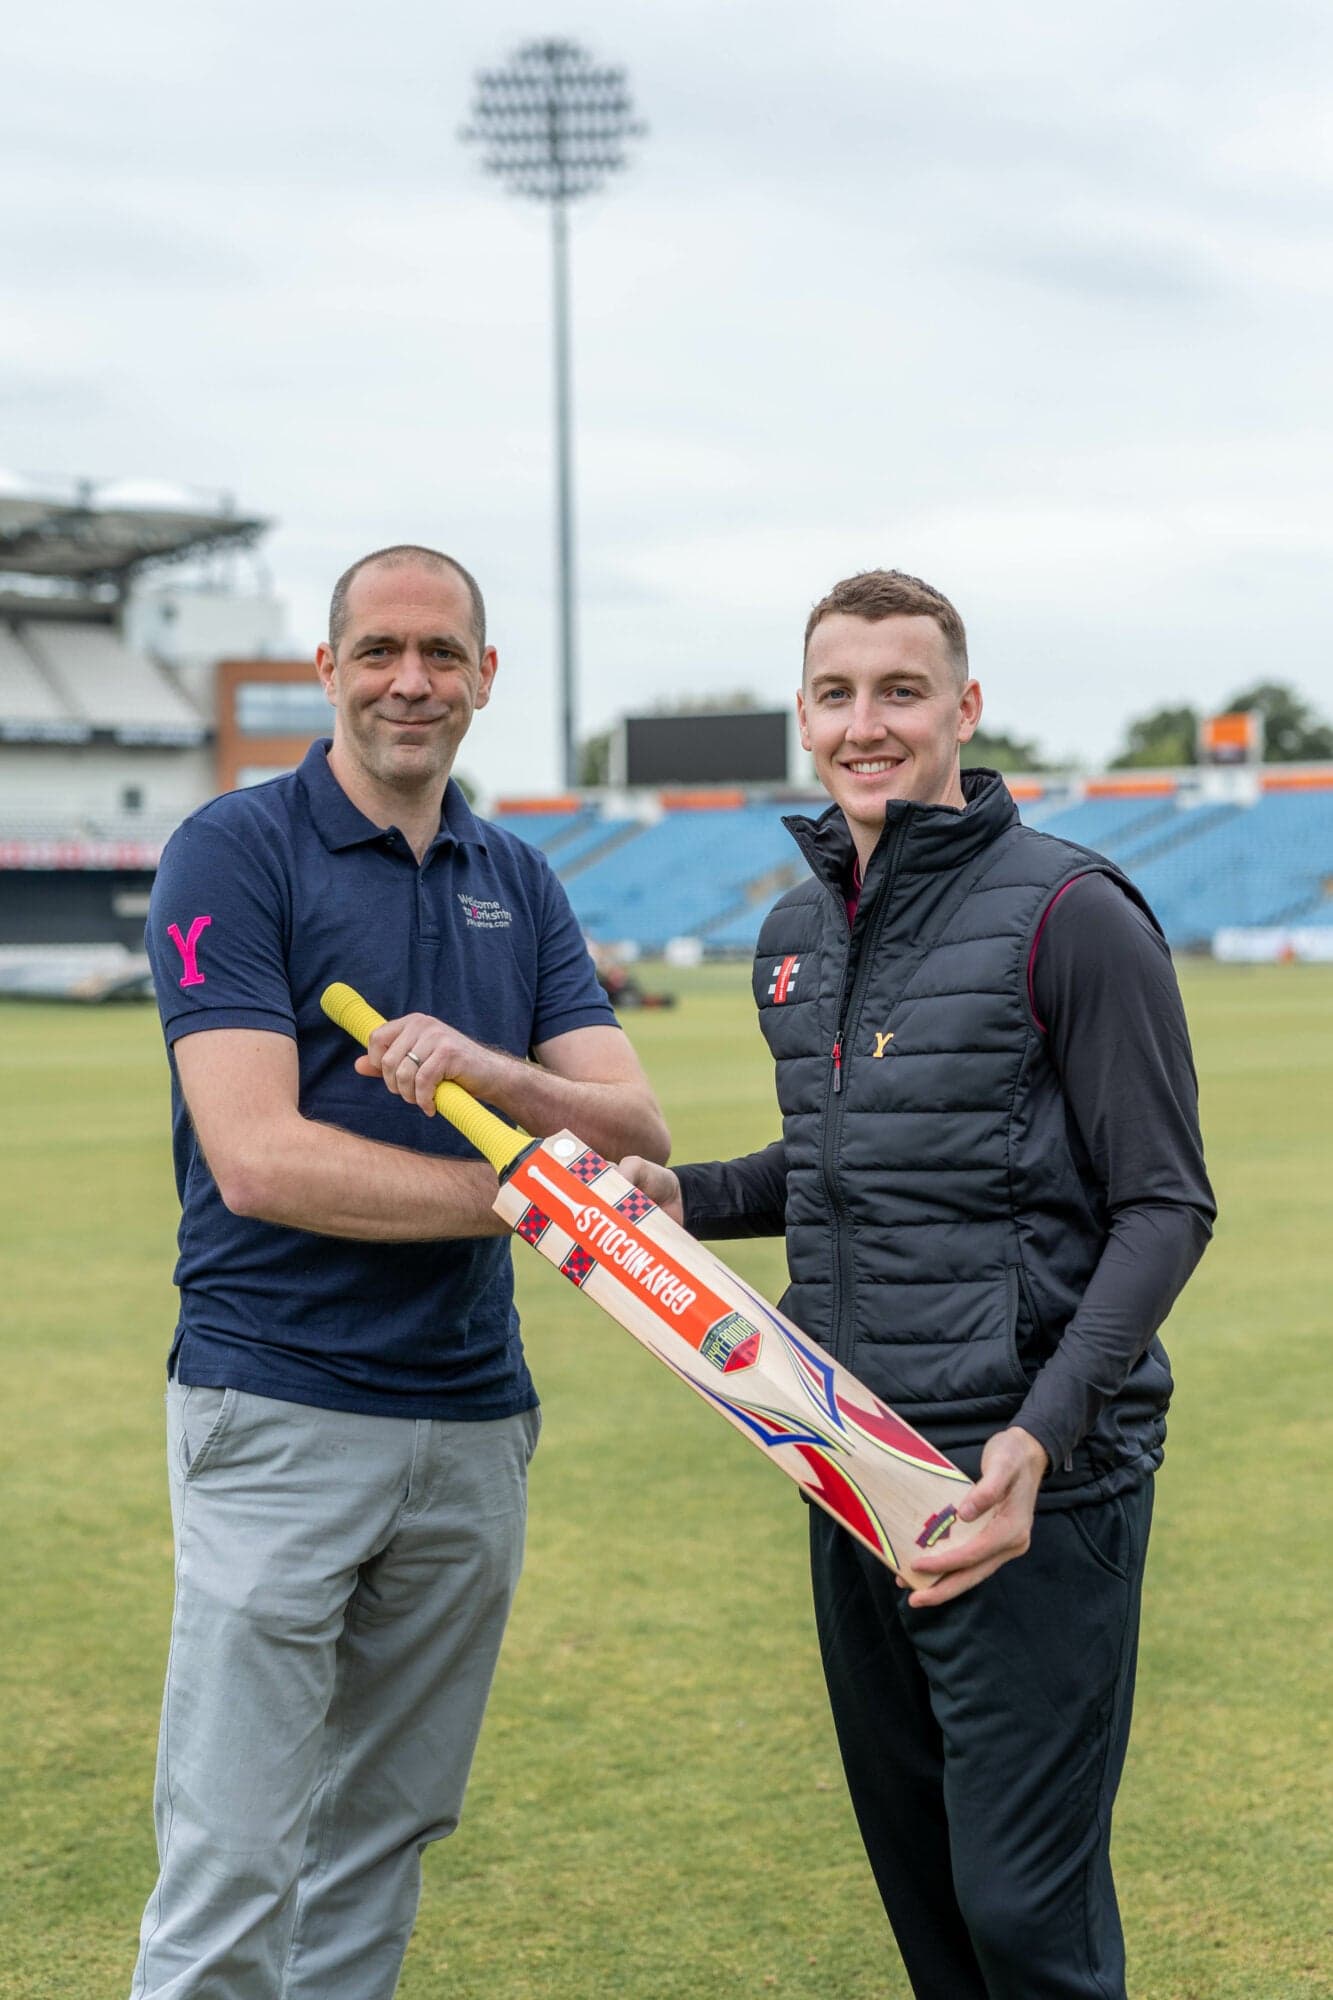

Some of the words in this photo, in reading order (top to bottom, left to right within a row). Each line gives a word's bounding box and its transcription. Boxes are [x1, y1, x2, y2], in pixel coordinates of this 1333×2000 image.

[168, 915, 211, 988] Y
[872, 1032, 895, 1058] Y
[576, 1206, 697, 1316] GRAY-NICOLLS
